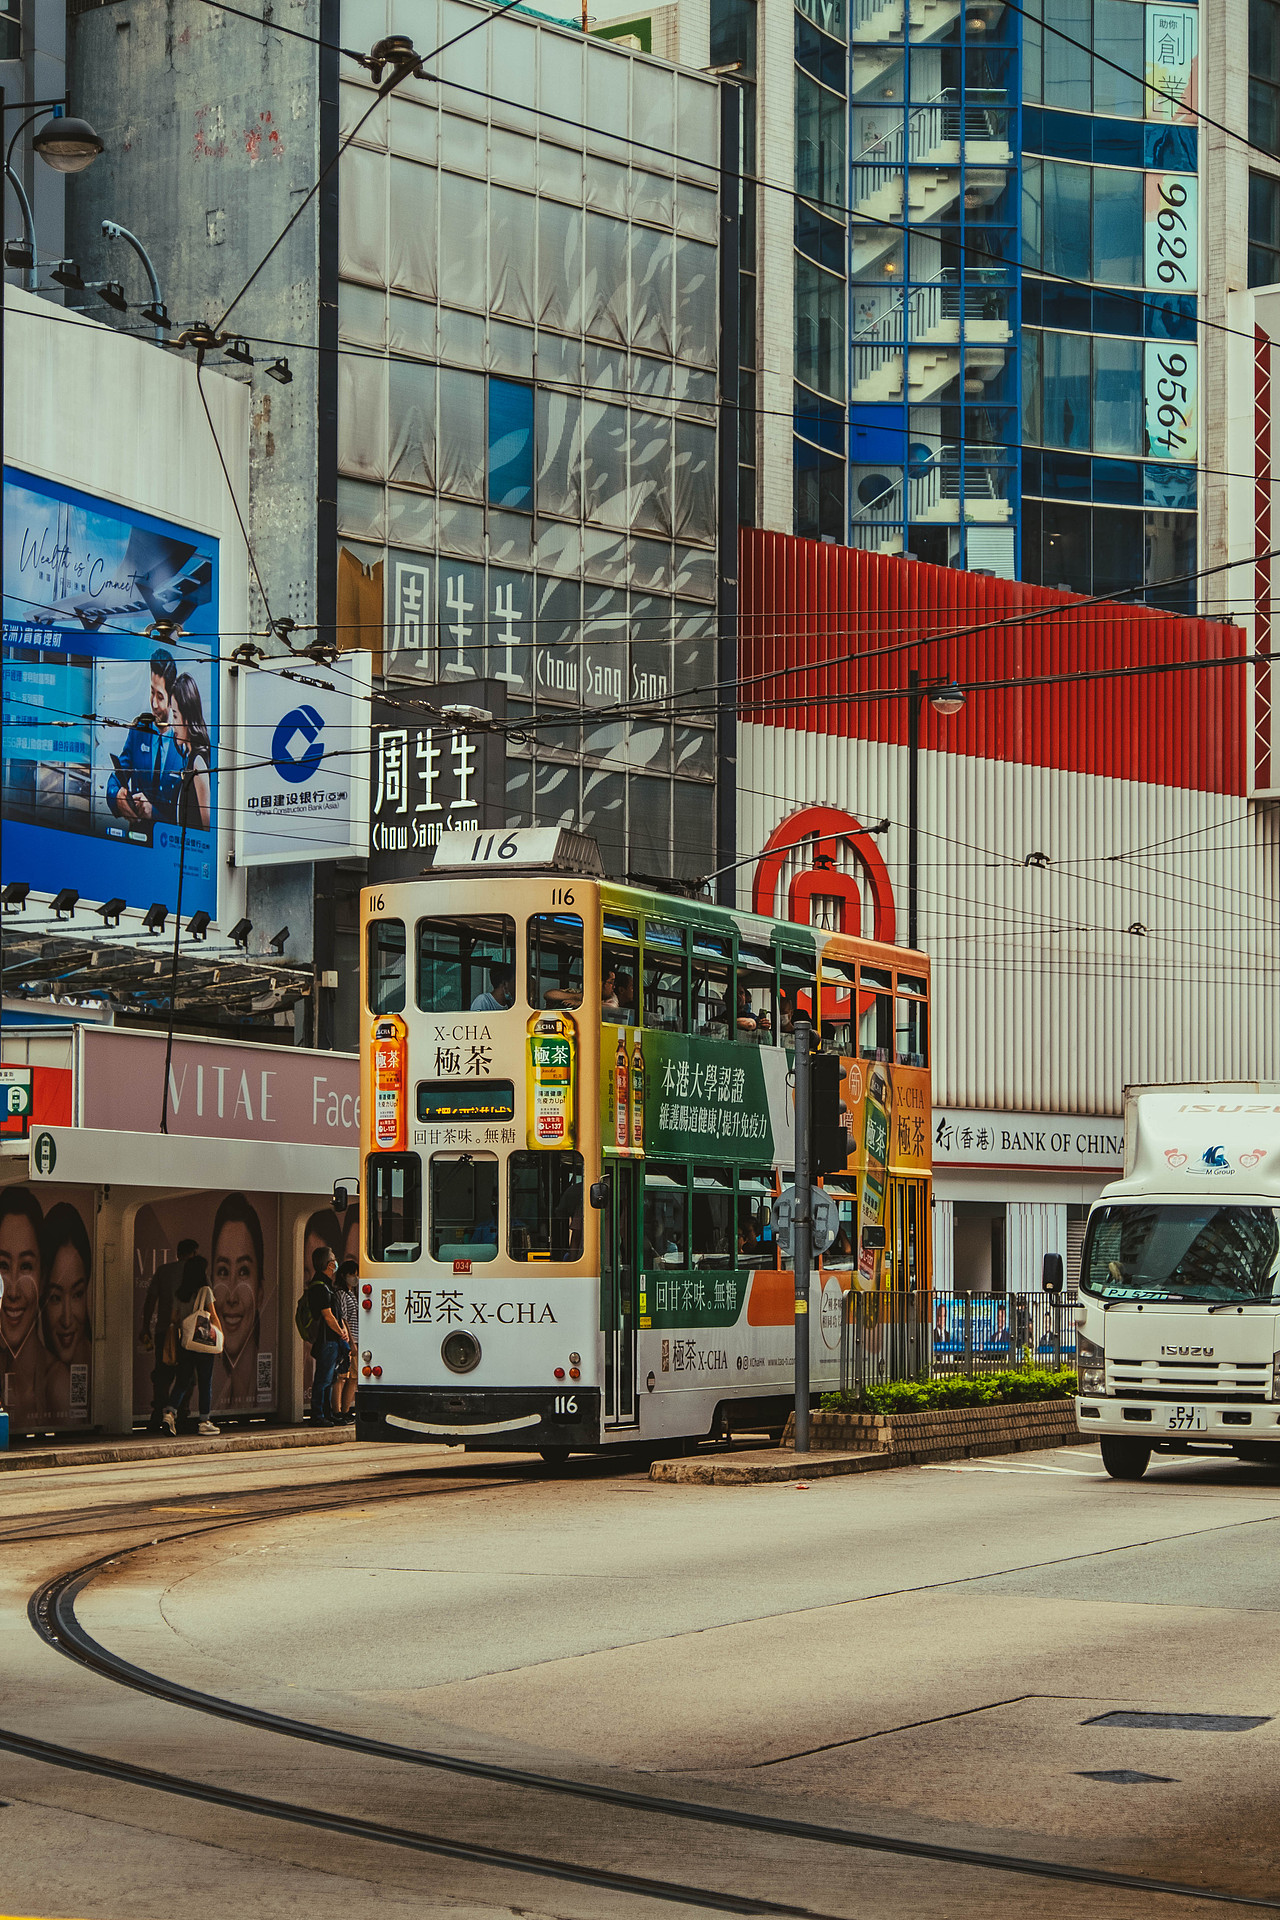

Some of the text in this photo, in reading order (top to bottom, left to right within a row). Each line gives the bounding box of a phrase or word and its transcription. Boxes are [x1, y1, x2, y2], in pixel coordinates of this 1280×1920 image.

[1159, 19, 1178, 30] 助你
[1158, 13, 1187, 118] 創業
[1157, 183, 1187, 283] 9626
[1157, 353, 1187, 450] 9564
[390, 561, 524, 684] 周生生
[537, 649, 667, 709] Chow Sang Sang
[374, 728, 478, 815] 周生生
[273, 804, 307, 814] Construction
[308, 803, 323, 811] Bank
[323, 802, 339, 810] (Asia)
[373, 822, 408, 851] Chow
[471, 832, 519, 861] 116
[369, 893, 385, 912] 116
[552, 888, 575, 906] 116
[434, 1025, 492, 1041] X-CHA
[375, 1050, 400, 1069] 極茶
[434, 1045, 493, 1076] 極茶
[534, 1045, 569, 1065] 極茶
[168, 1063, 277, 1122] VITAE
[661, 1058, 745, 1103] 本港大學認證
[897, 1086, 925, 1109] X-CHA
[1178, 1105, 1280, 1113] ISUZ
[414, 1128, 516, 1145] 回甘茶味。無糖
[867, 1115, 886, 1159] 極茶
[897, 1115, 925, 1157] 極茶
[1001, 1130, 1124, 1154] BANK OF CHINA
[455, 1261, 470, 1271] 034
[656, 1279, 737, 1311] 回甘茶味。無糖
[1108, 1289, 1128, 1297] PJ
[404, 1289, 558, 1324] 極茶 X-CHA
[673, 1339, 728, 1372] 極茶 X-CHA
[1161, 1345, 1214, 1356] ISUZU
[554, 1395, 578, 1414] 116
[1177, 1406, 1195, 1418] PJ
[1168, 1418, 1200, 1429] 5771
